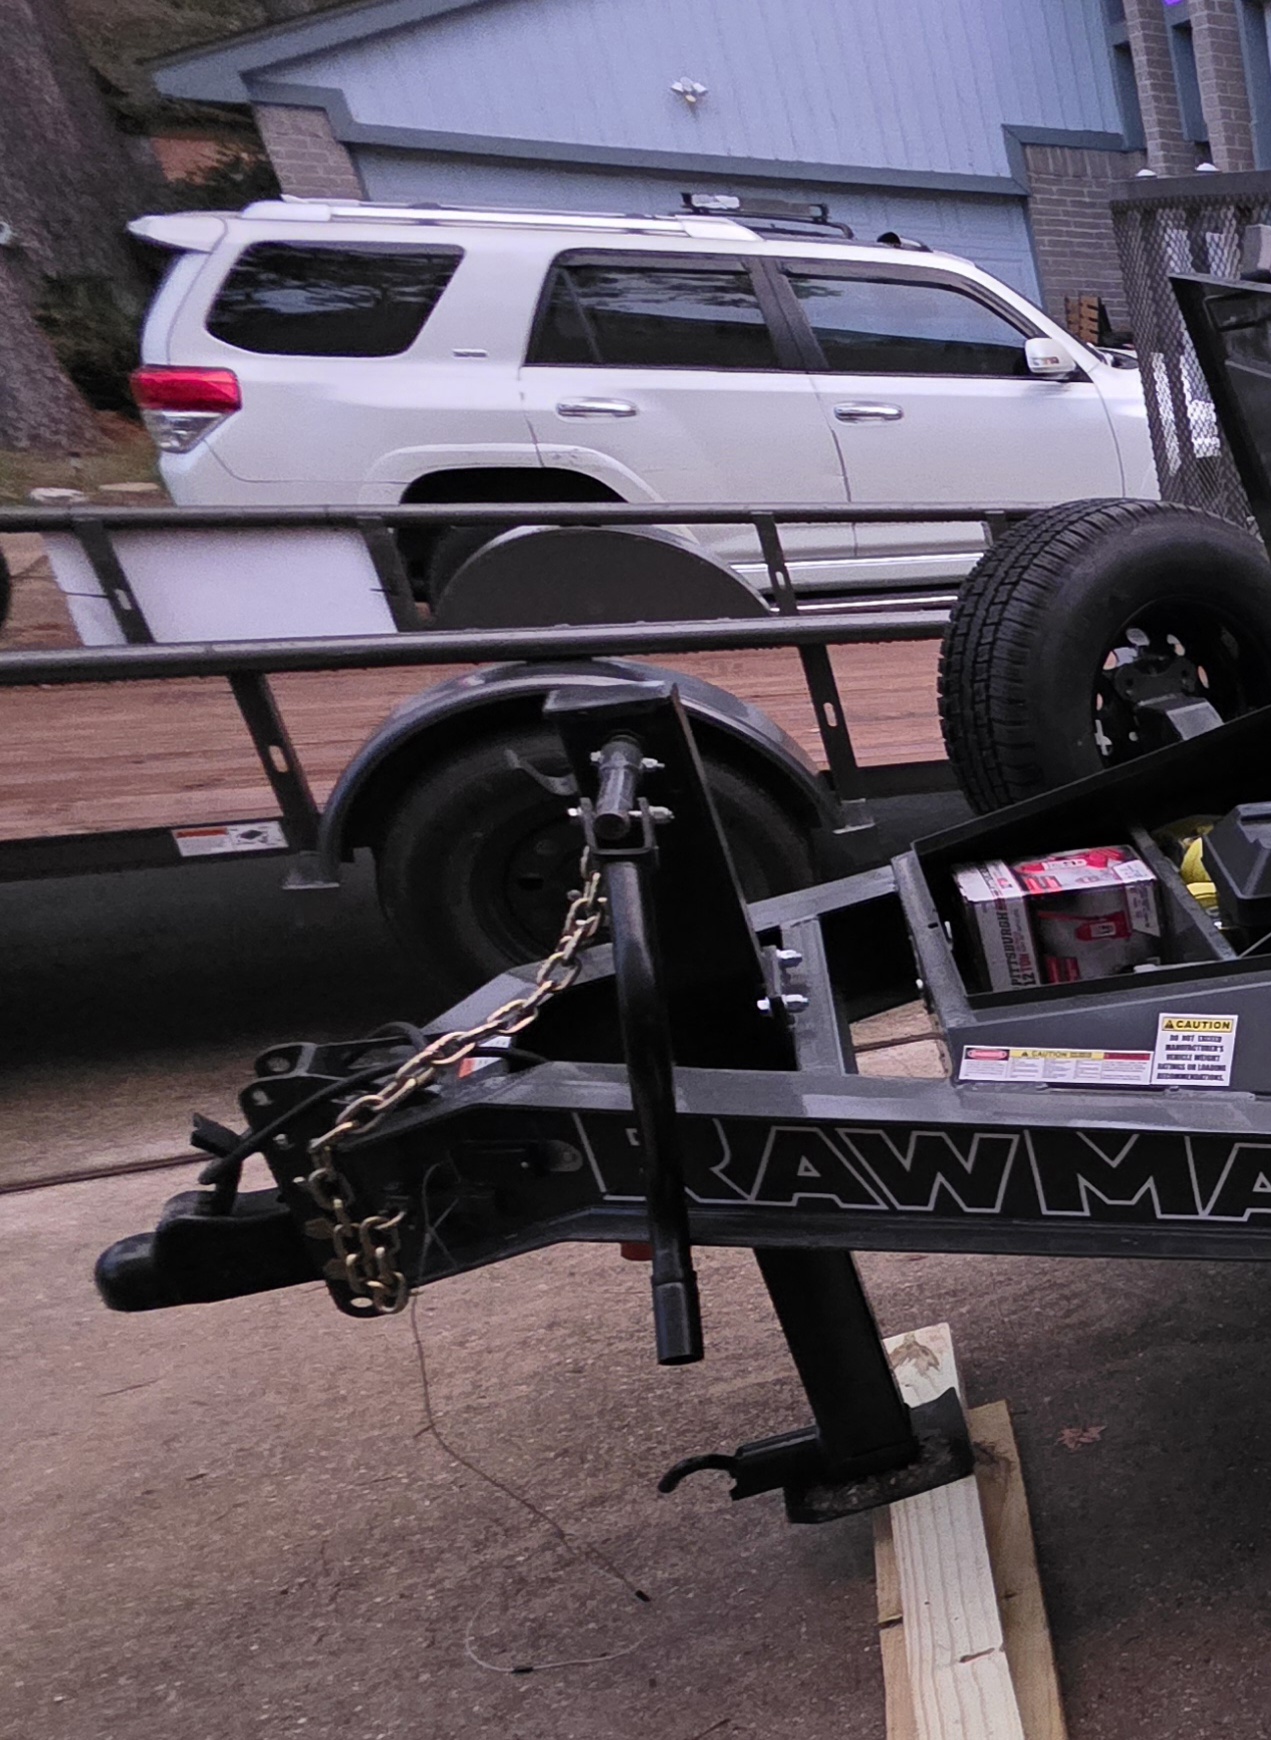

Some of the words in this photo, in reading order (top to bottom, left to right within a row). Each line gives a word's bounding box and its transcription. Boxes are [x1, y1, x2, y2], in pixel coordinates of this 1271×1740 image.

[996, 911, 1022, 987] PITTSBURGH
[1175, 1020, 1231, 1030] CAUTION
[1031, 1050, 1068, 1059] CAUTION
